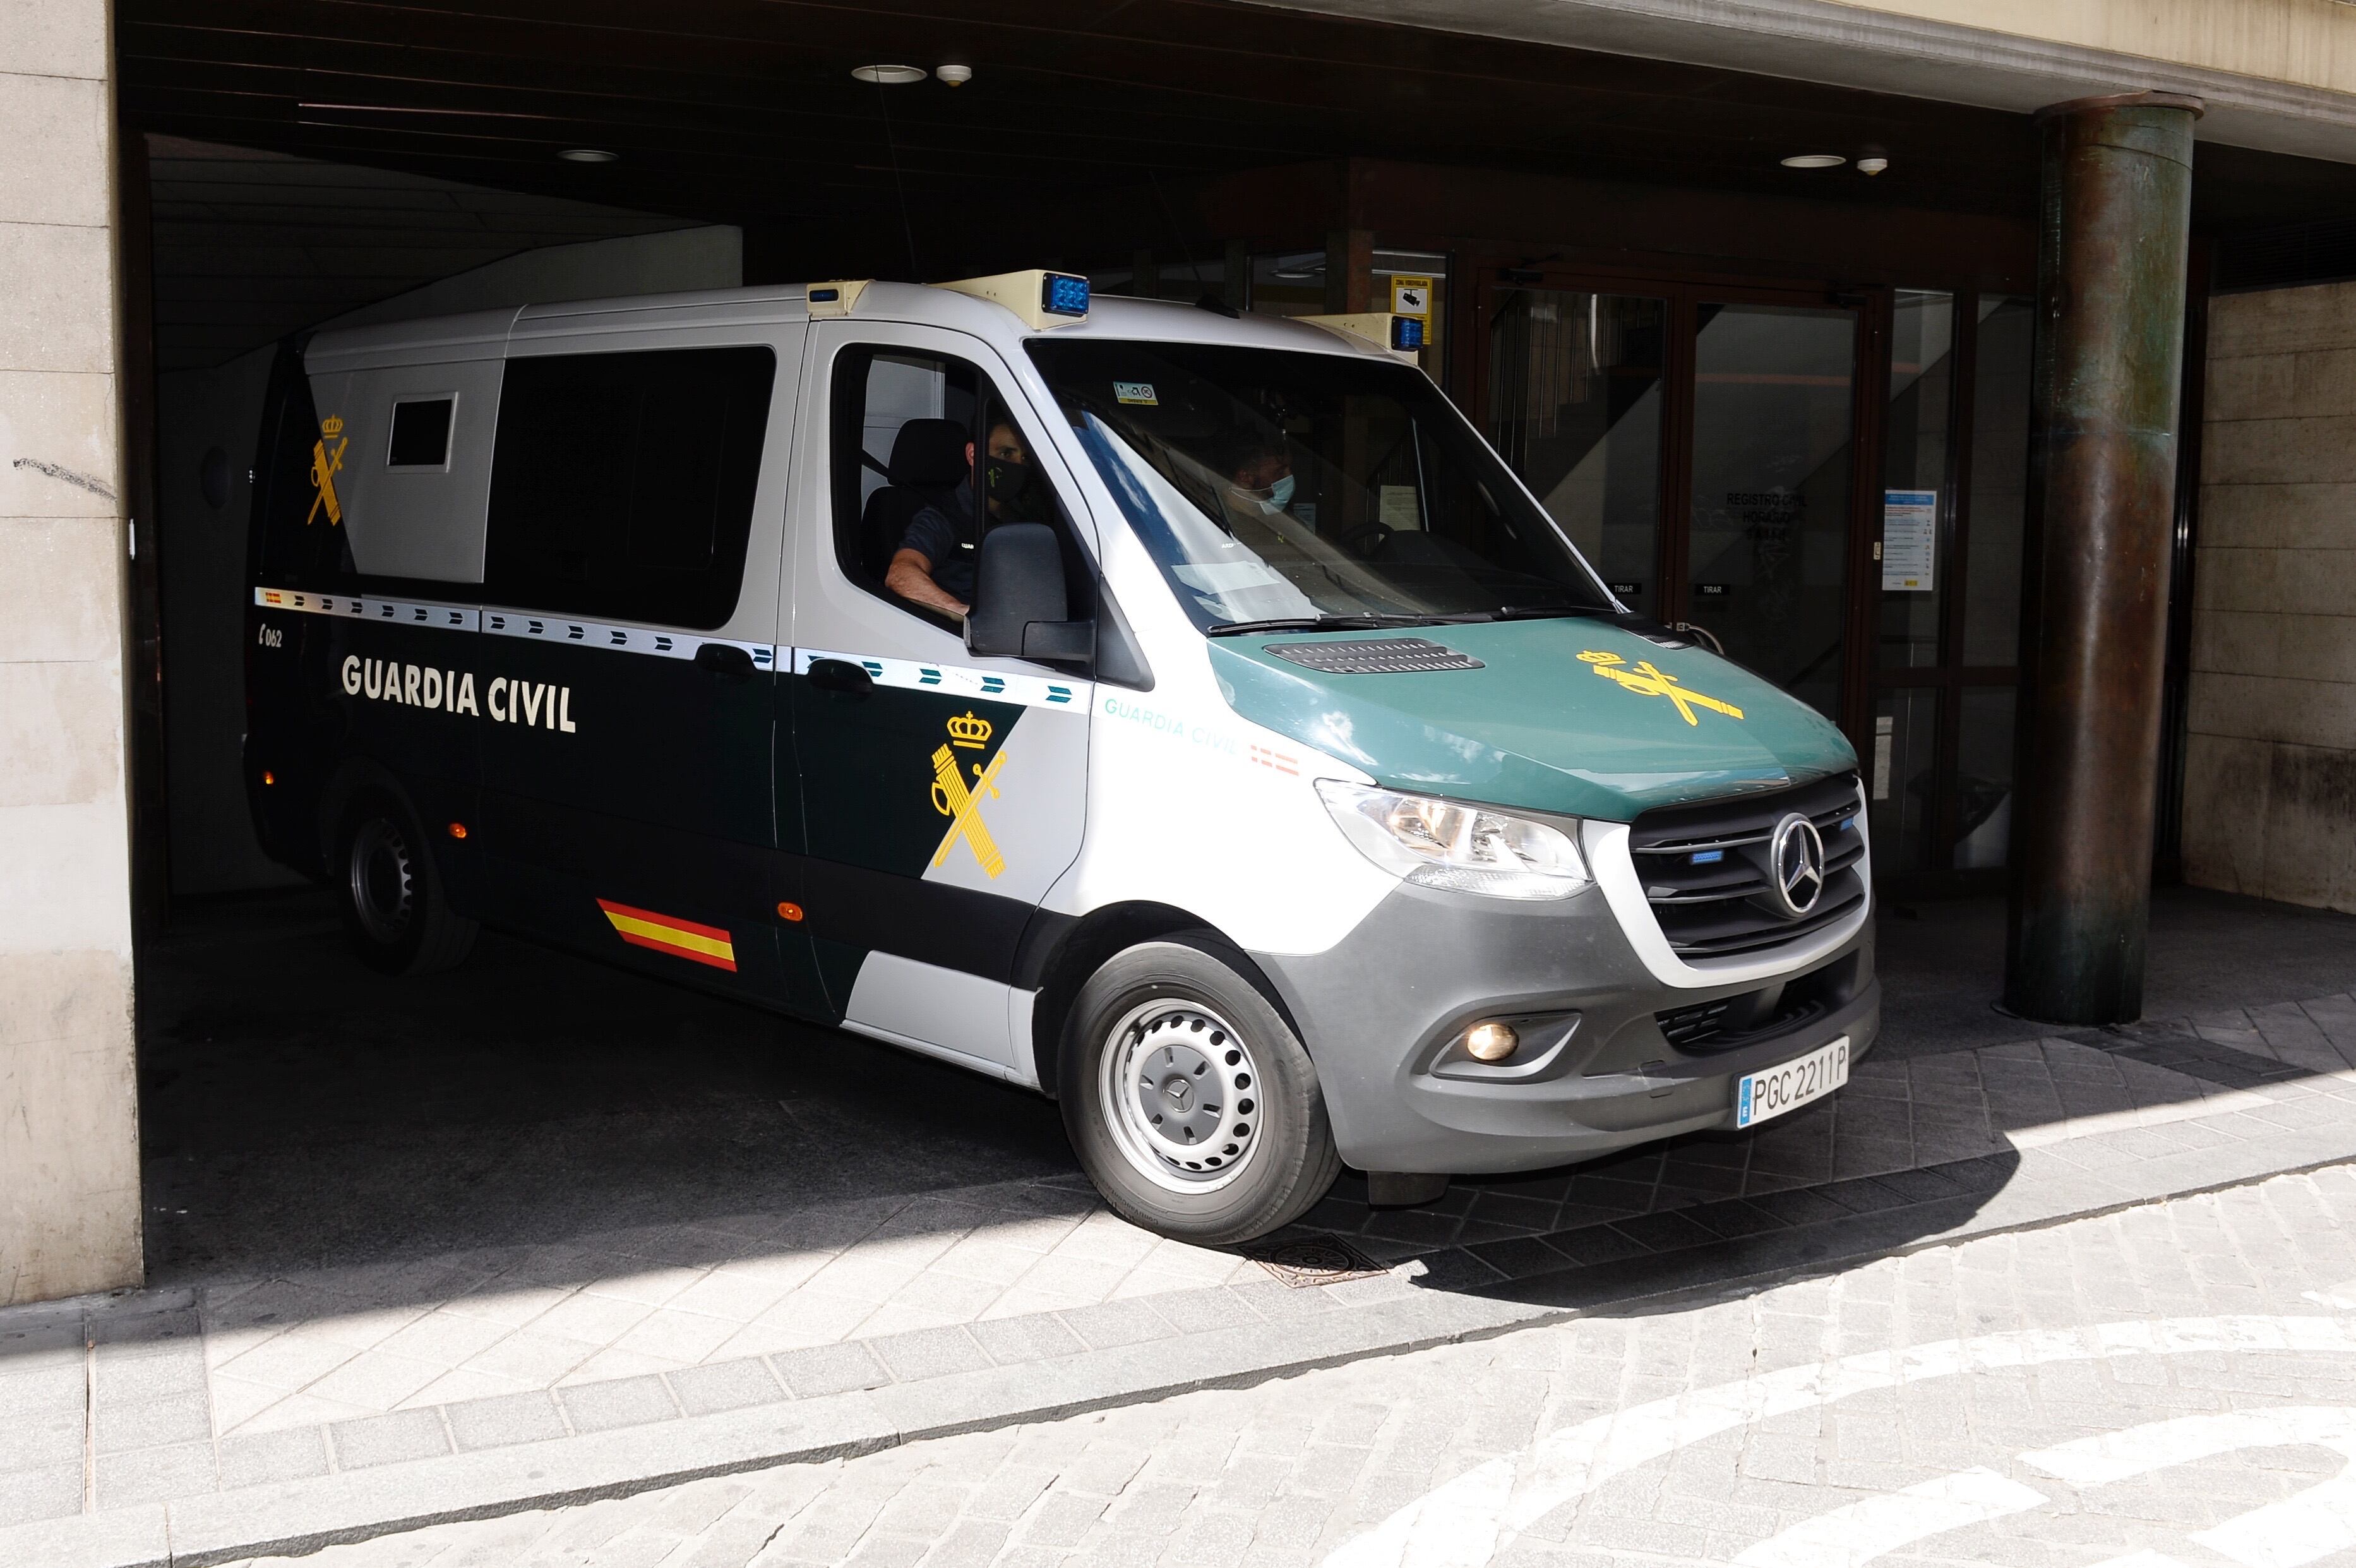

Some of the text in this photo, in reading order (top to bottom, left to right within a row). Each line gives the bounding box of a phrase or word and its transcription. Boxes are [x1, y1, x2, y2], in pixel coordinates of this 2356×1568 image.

[1726, 493, 1779, 506] REGISTRO
[1614, 585, 1634, 593] TIRAR
[265, 628, 282, 647] 062
[342, 655, 576, 733] GUARDIA CIVIL
[1104, 698, 1236, 755] GUARDIA CIVIL
[1754, 1070, 1791, 1115] PGC
[1742, 1106, 1748, 1117] E
